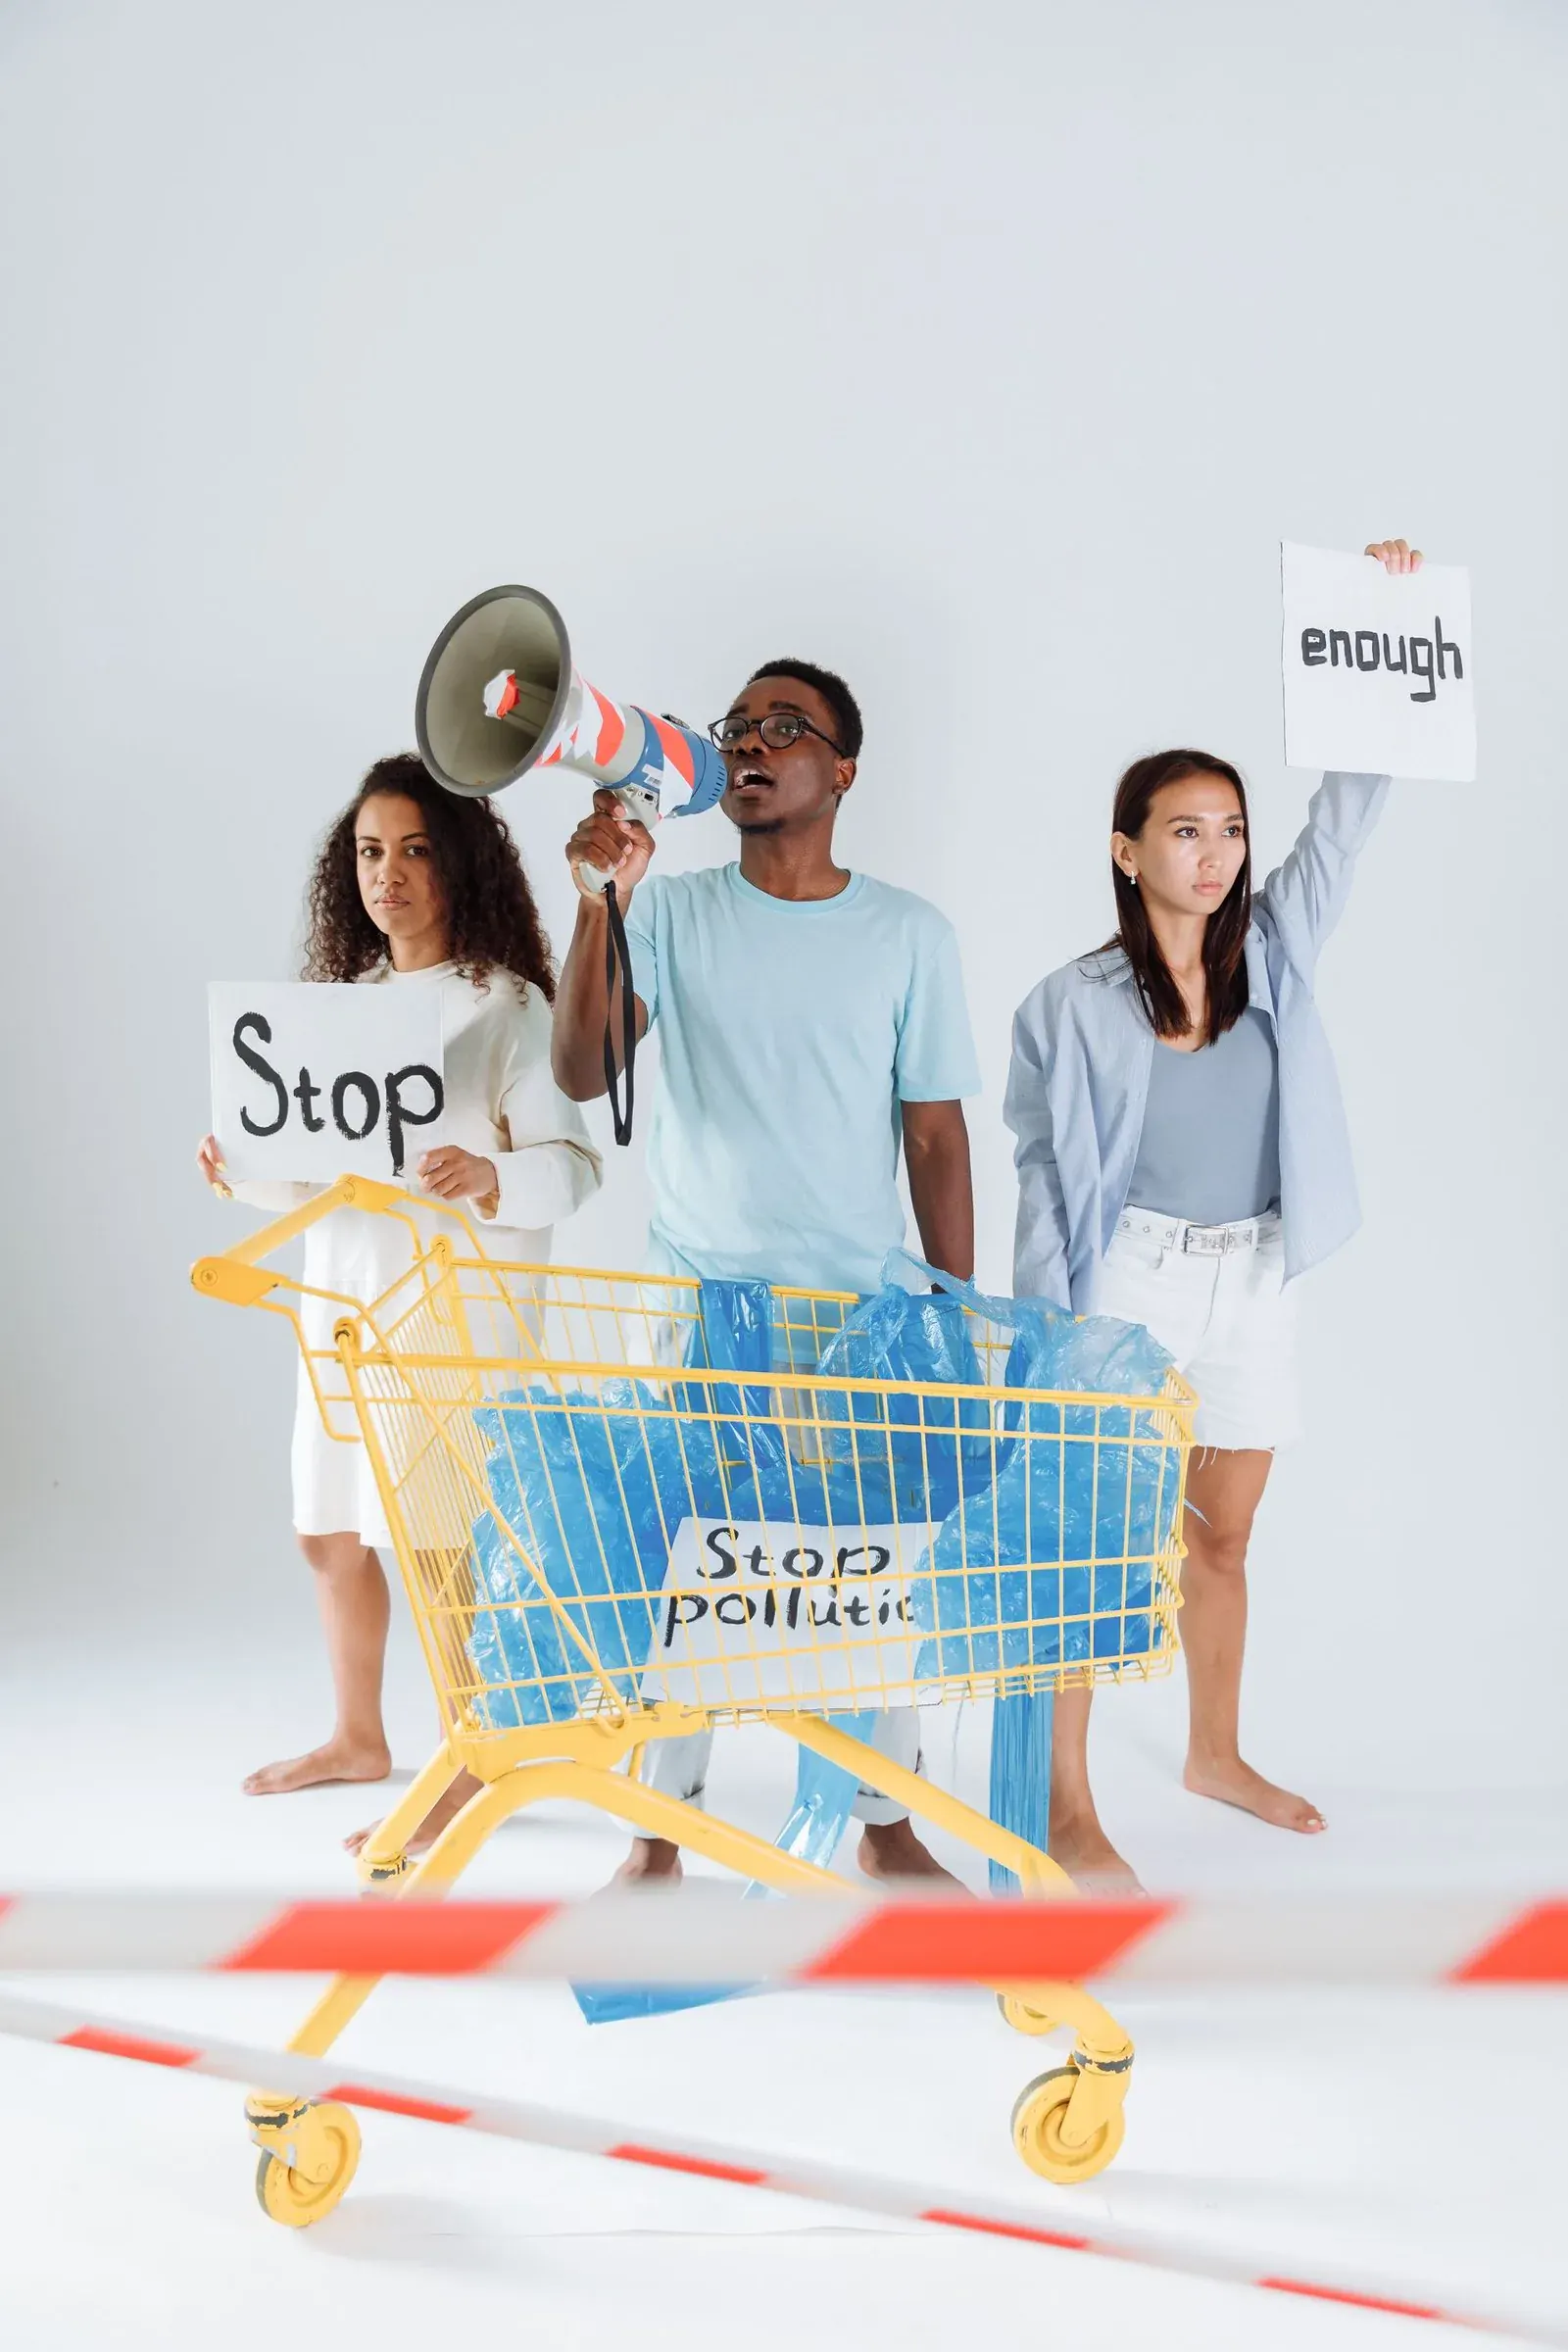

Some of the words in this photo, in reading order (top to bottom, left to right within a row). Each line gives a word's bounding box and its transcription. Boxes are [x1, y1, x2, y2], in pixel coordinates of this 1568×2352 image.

[1301, 615, 1463, 703] enough
[232, 1010, 445, 1178] Stop
[696, 1526, 891, 1598] Stop
